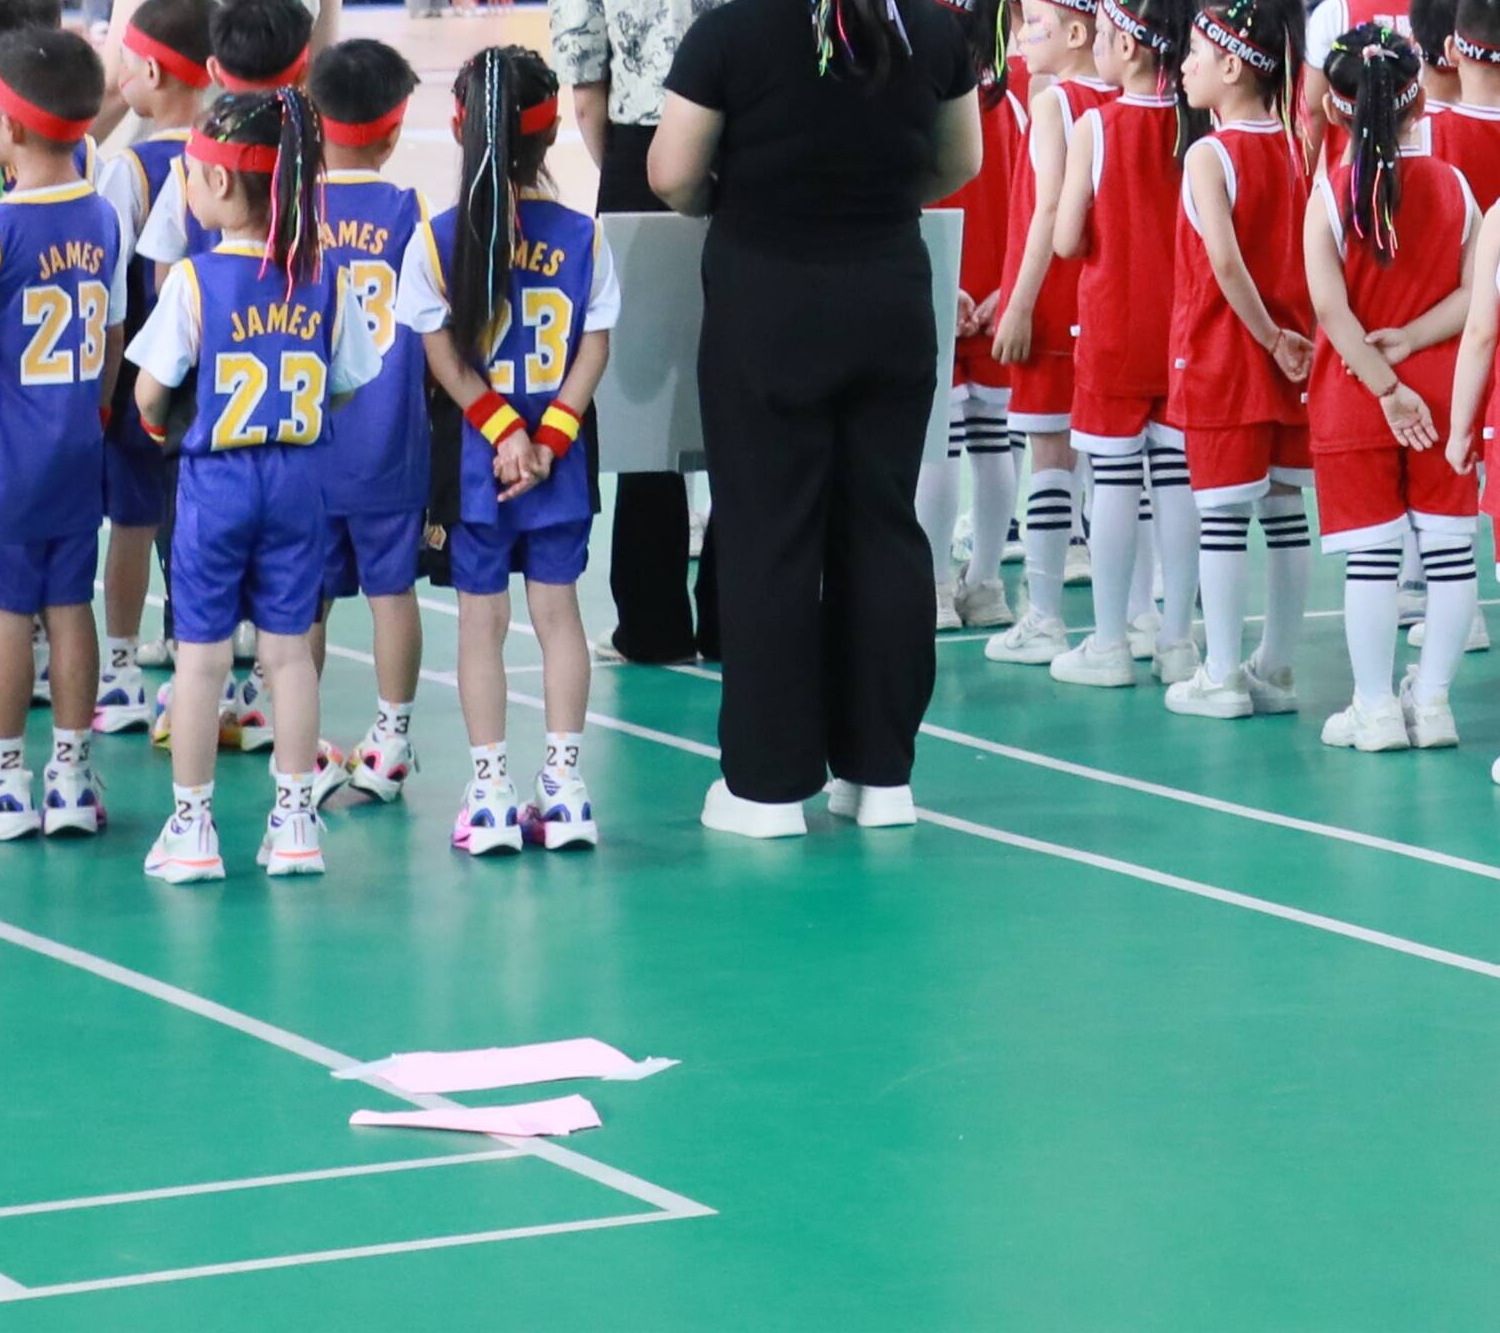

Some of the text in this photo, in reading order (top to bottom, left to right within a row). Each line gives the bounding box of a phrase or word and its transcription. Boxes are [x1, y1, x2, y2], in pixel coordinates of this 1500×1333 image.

[319, 219, 389, 255] AMES
[38, 243, 105, 282] JAMES
[508, 239, 566, 277] MES
[20, 283, 108, 386] 23
[230, 301, 322, 345] JAMES
[210, 351, 329, 451] 23
